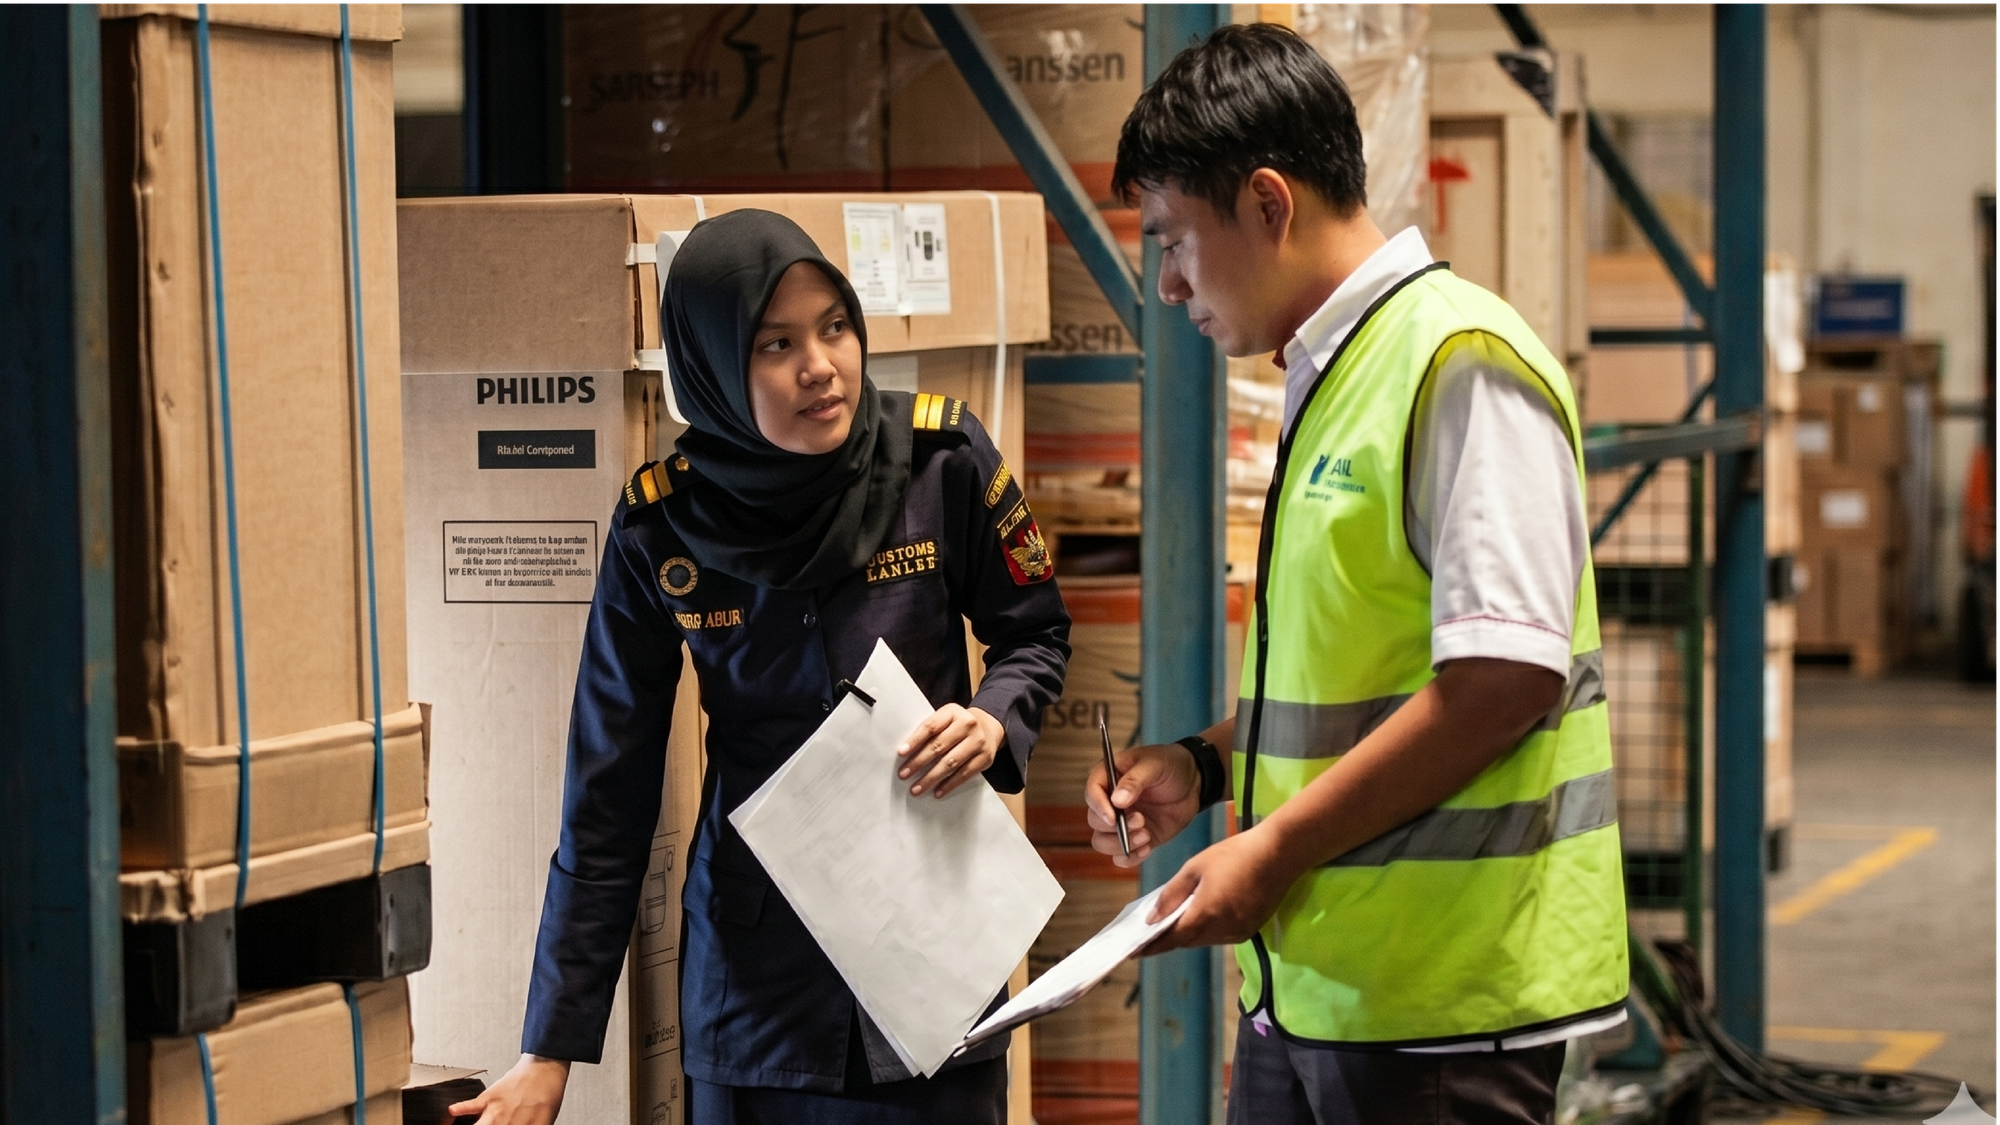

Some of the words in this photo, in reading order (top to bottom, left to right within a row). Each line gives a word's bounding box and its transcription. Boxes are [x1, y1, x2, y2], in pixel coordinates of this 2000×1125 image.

[1027, 323, 1123, 352] ssen
[477, 376, 596, 405] PHILIPS
[705, 609, 742, 628] ABUR
[1042, 700, 1109, 729] sen
